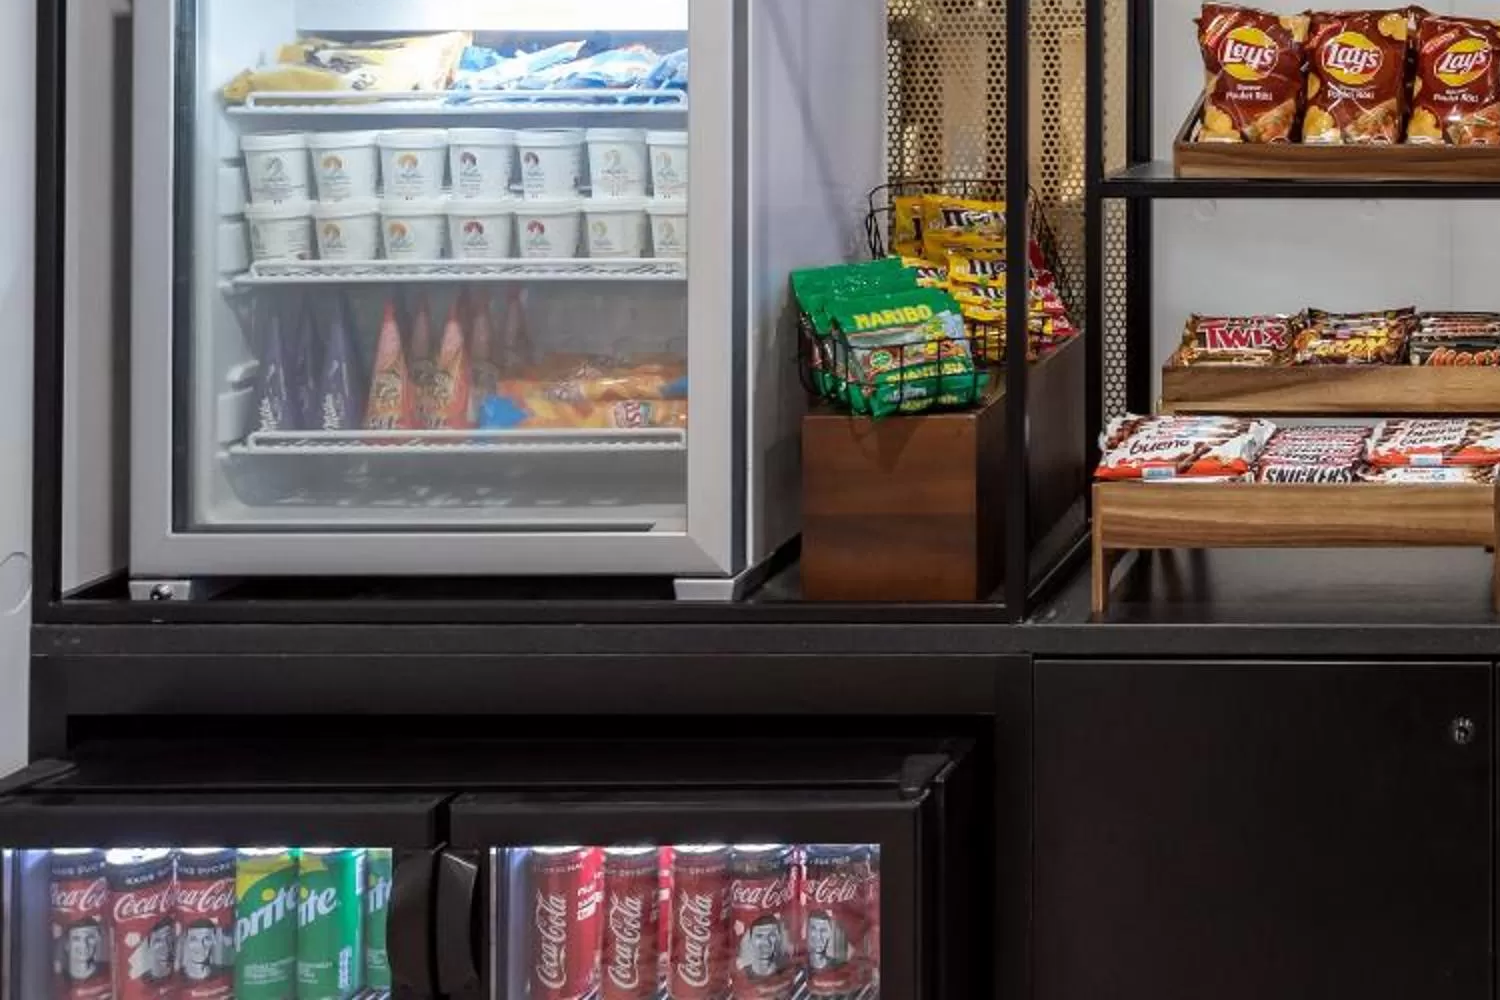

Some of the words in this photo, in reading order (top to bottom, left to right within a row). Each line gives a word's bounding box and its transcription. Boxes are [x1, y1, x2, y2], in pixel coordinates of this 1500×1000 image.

[852, 303, 934, 331] HARIBO
[1129, 439, 1190, 455] bueno
[235, 883, 299, 953] prite
[536, 888, 568, 989] Coca-Cola
[607, 889, 644, 989] Coca-Cola
[677, 887, 714, 989] Coca-Cola
